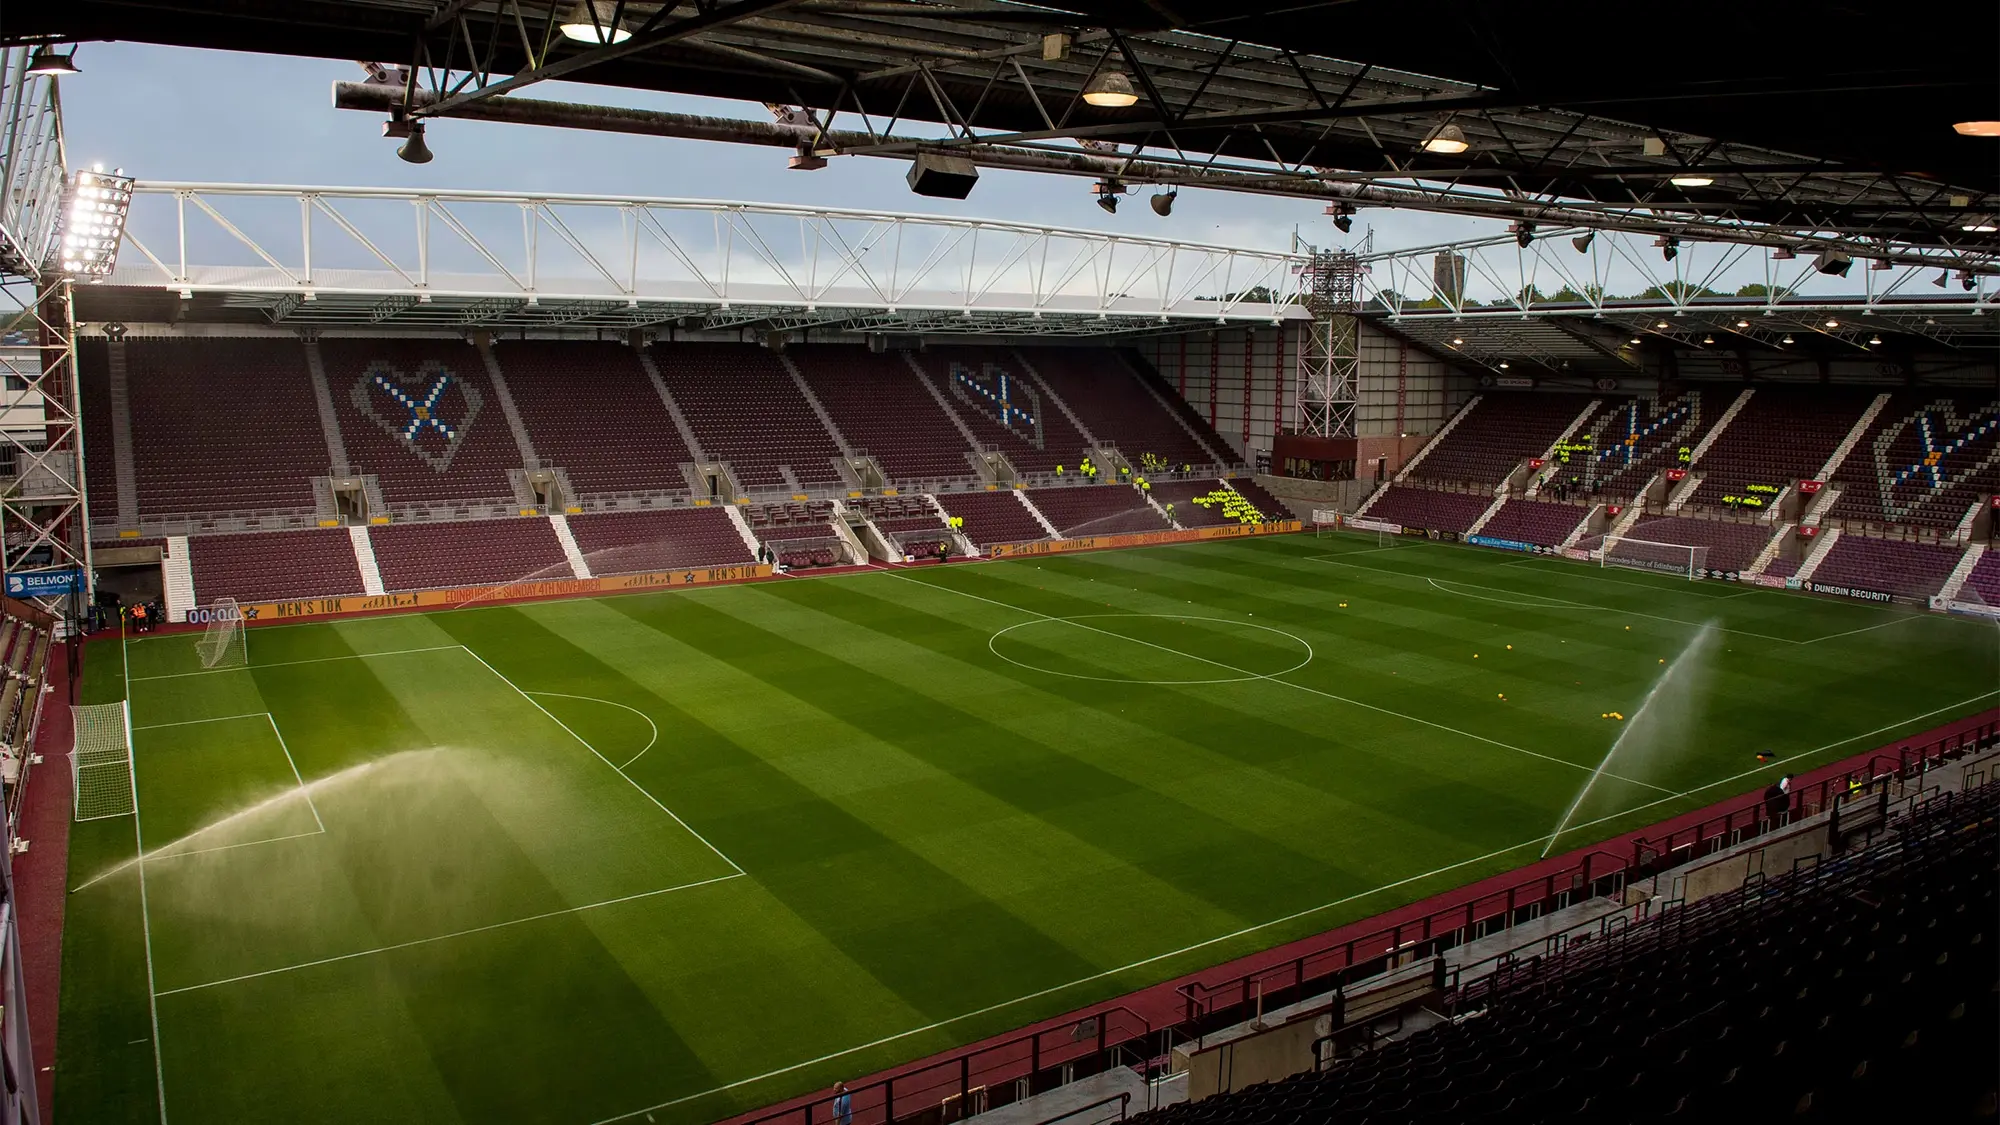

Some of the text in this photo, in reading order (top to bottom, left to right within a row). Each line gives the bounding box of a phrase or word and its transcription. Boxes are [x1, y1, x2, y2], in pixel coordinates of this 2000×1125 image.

[1012, 541, 1050, 555] MEN'S 10K
[1605, 555, 1685, 573] Mercedes-Benz of Edinburgh
[708, 566, 757, 581] MEN'S 10K
[445, 587, 496, 603] EDINBURGH
[503, 583, 537, 599] SUNDAY
[539, 582, 555, 596] 4TH
[556, 578, 600, 594] NOVEMBER
[1814, 583, 1849, 596] DUNEDIN
[1850, 588, 1891, 602] SECURITY
[188, 607, 237, 624] 00:00
[277, 599, 342, 617] MEN'S 10K
